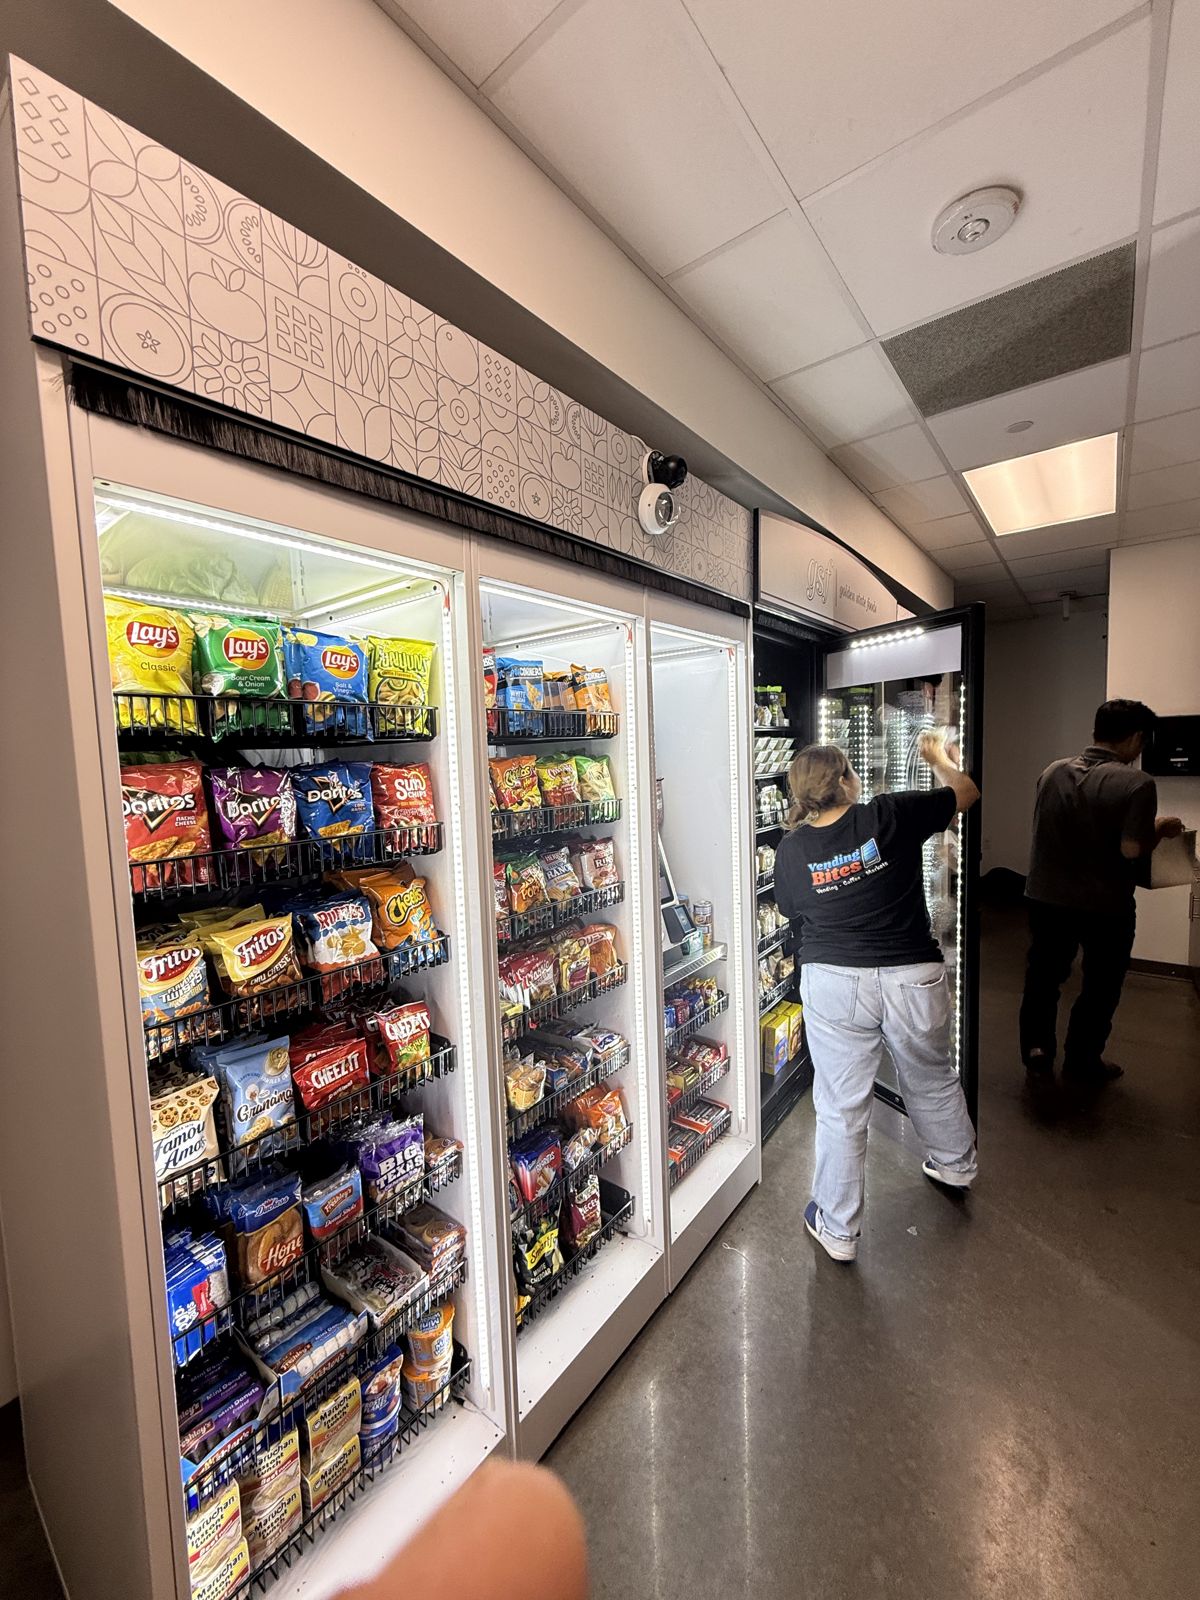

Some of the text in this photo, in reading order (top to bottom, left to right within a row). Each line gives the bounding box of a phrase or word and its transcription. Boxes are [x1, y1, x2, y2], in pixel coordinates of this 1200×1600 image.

[130, 621, 178, 648] Lay's
[228, 637, 268, 660] Lay's
[325, 651, 358, 671] Lay's
[140, 661, 177, 673] Classic
[249, 674, 271, 682] Cream
[394, 778, 426, 800] Sun
[407, 790, 427, 798] CHIPS
[122, 793, 195, 815] Doritos
[227, 795, 286, 818] Dorito
[807, 848, 861, 872] Vending
[811, 861, 862, 887] Bites
[816, 884, 839, 894] Vending
[865, 861, 889, 875] Markets
[233, 926, 285, 967] Fritos
[139, 946, 201, 983] Fritos
[250, 975, 267, 986] CHILI
[266, 956, 291, 978] CHEESE
[154, 1121, 205, 1162] Famou
[376, 1154, 425, 1190] TEXAS
[379, 1144, 417, 1176] BIG
[255, 1195, 290, 1218] Duchess
[262, 1234, 303, 1271] Hone
[217, 1386, 260, 1419] Mini Donuts
[319, 1388, 358, 1421] Maruchan
[323, 1402, 350, 1427] Instant
[326, 1410, 348, 1430] Lunch
[249, 1437, 294, 1469] Maruchan
[253, 1451, 285, 1475] Instant
[320, 1444, 357, 1481] Maruchan
[257, 1459, 282, 1479] Lunch
[323, 1459, 349, 1486] Instant
[326, 1466, 347, 1488] Lunch
[187, 1495, 235, 1541] Maruchan
[254, 1492, 297, 1532] Maruchan
[258, 1508, 288, 1538] Instant
[191, 1513, 224, 1548] Instant
[195, 1523, 222, 1549] Lunch
[262, 1516, 286, 1540] Lunch
[196, 1551, 244, 1600] Maruchan
[210, 1579, 231, 1600] unch
